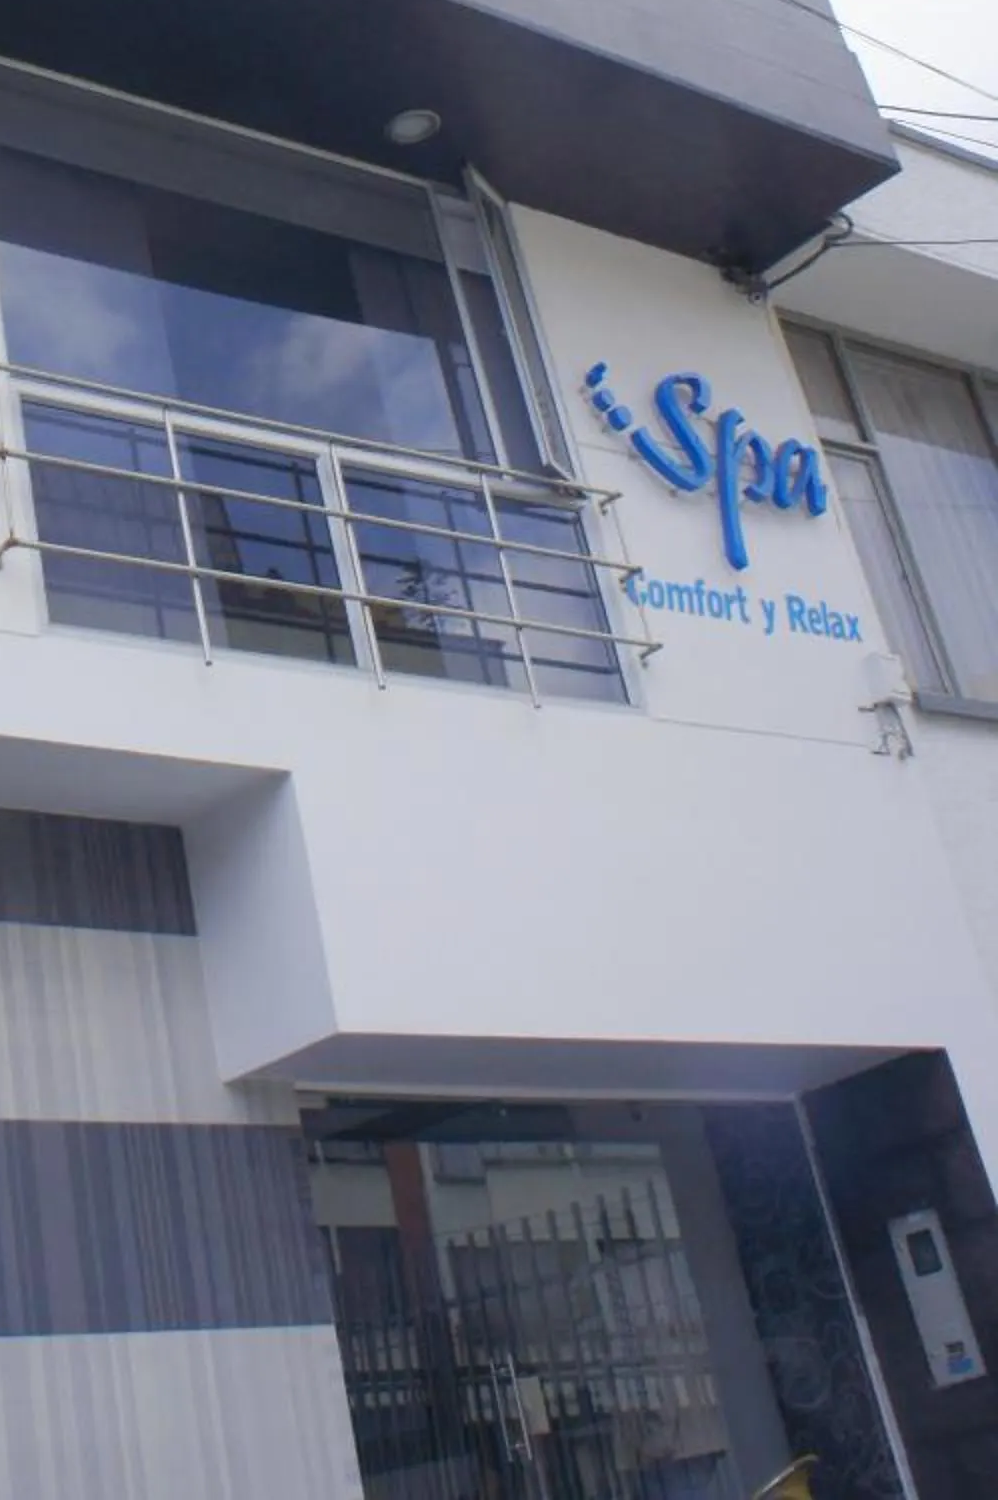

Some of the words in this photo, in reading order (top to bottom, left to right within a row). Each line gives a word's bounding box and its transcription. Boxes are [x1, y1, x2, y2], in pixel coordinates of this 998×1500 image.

[626, 573, 750, 625] Comfort
[760, 597, 776, 636] y
[785, 594, 863, 643] Relax
